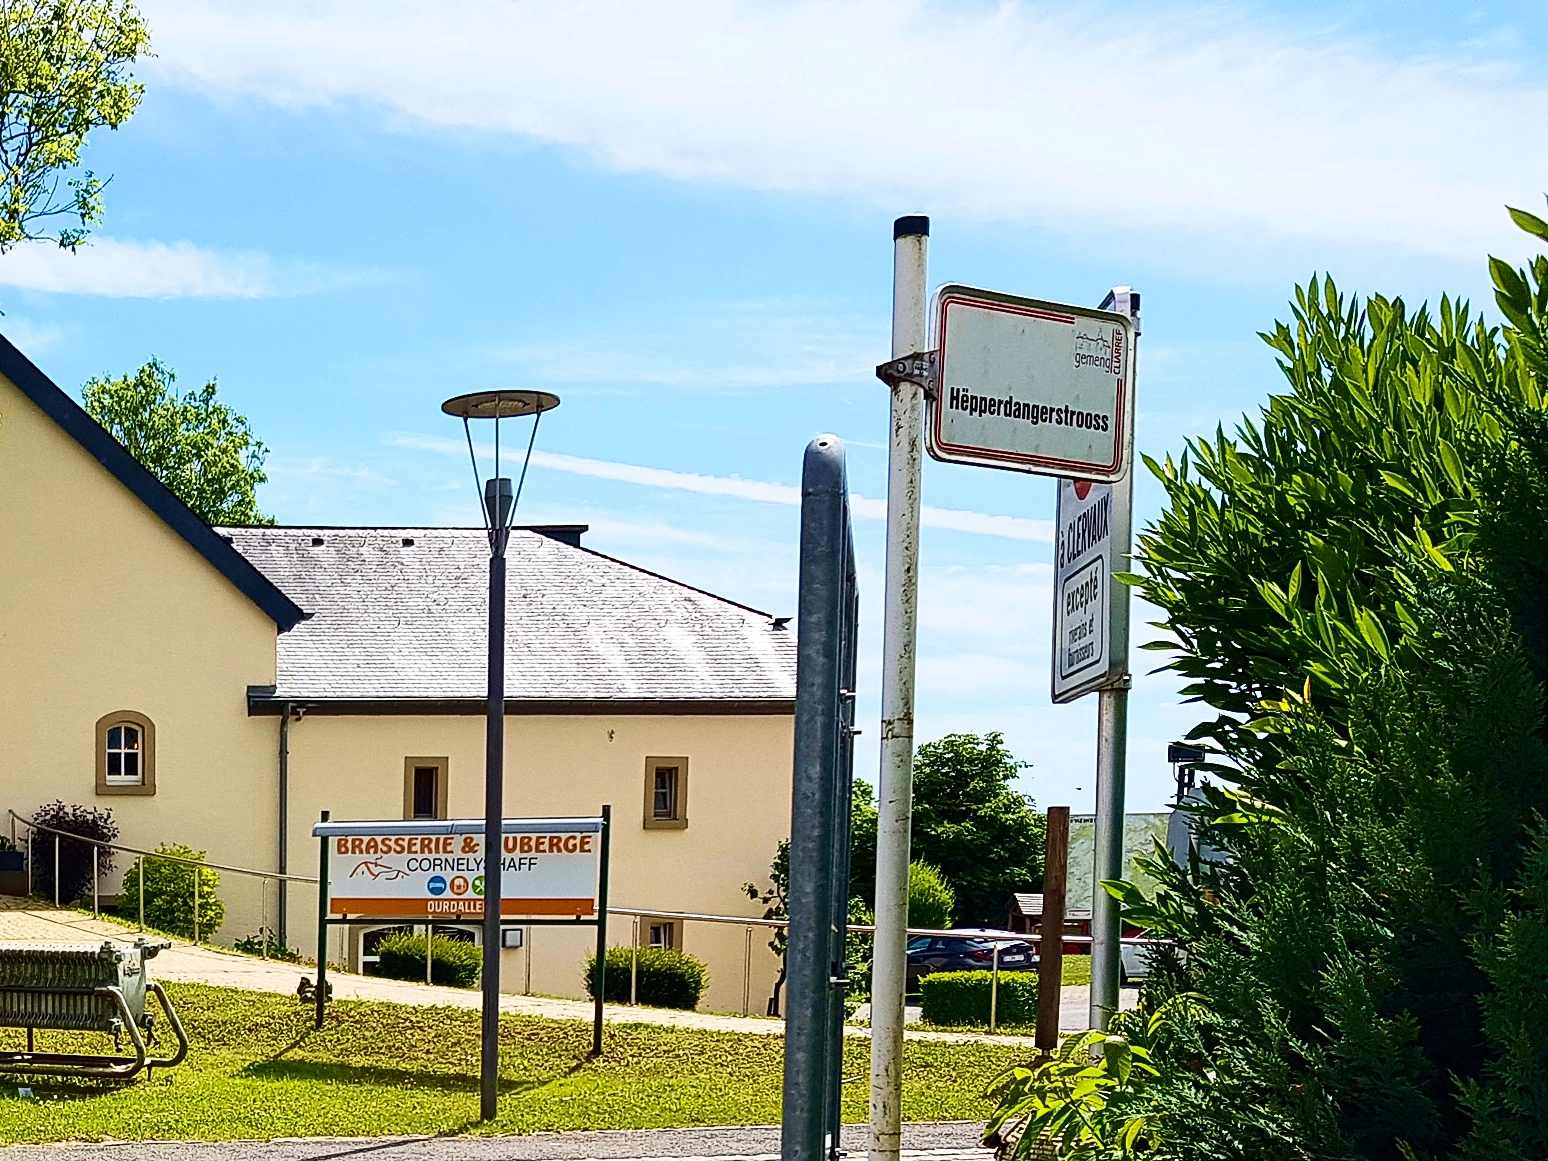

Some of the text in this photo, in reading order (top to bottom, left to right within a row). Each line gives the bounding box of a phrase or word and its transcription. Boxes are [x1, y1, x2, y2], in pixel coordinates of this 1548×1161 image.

[1074, 352, 1111, 374] gemeng
[950, 386, 1110, 433] Hëpperdangerstrooss
[1067, 492, 1110, 564] CLERVAUX
[1066, 567, 1099, 616] excepté
[336, 835, 593, 855] BRASSERIE & UBERGE
[406, 857, 539, 872] CORNELYHAFF
[427, 900, 485, 913] OURDALLE
